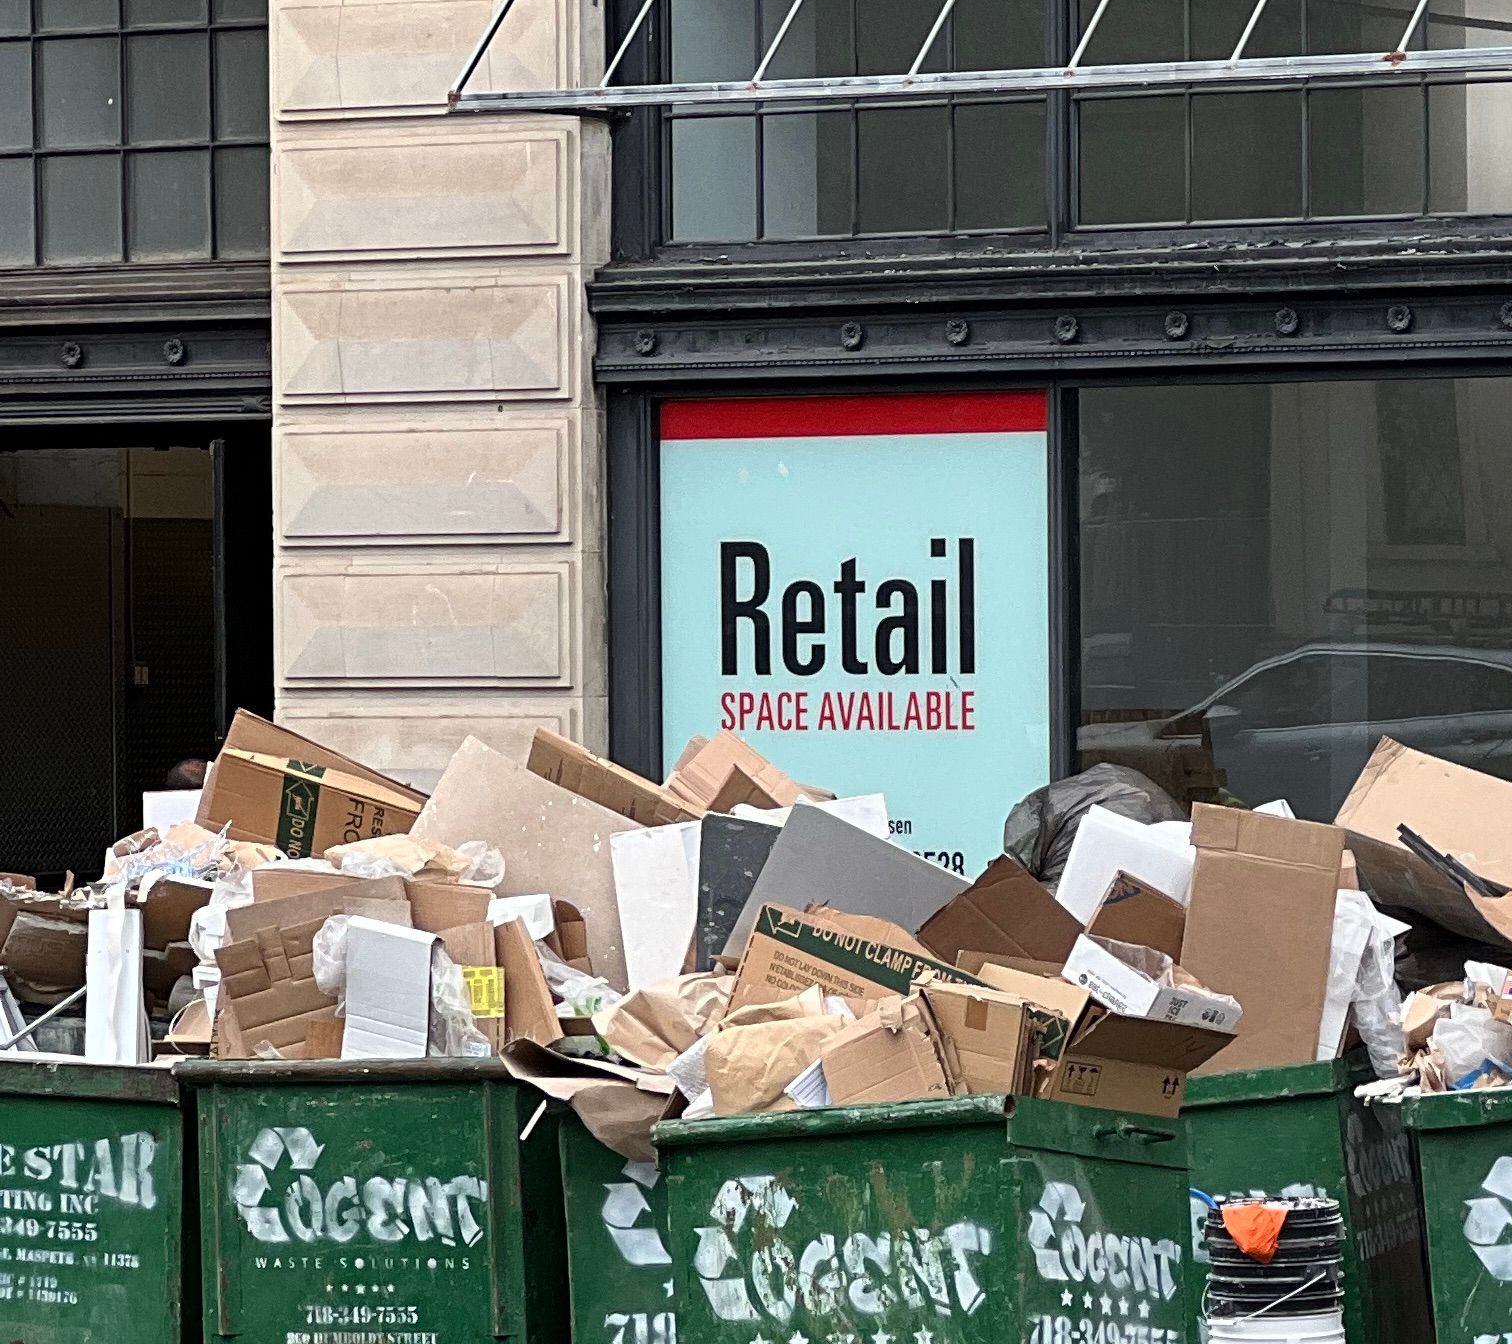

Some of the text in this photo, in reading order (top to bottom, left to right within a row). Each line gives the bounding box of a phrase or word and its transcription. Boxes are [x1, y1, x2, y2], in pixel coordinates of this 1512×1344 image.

[719, 537, 977, 677] Retail
[720, 689, 976, 732] SPACE AVAILABLE
[887, 819, 913, 835] sen
[286, 839, 304, 860] NO
[864, 941, 913, 975] CLAMP
[23, 1130, 157, 1210] STAR
[0, 1189, 99, 1215] TING INC
[0, 1215, 99, 1242] 349-7555
[254, 1256, 471, 1271] WASTE SOLUTIONS
[305, 1305, 419, 1325] 718-349-7555
